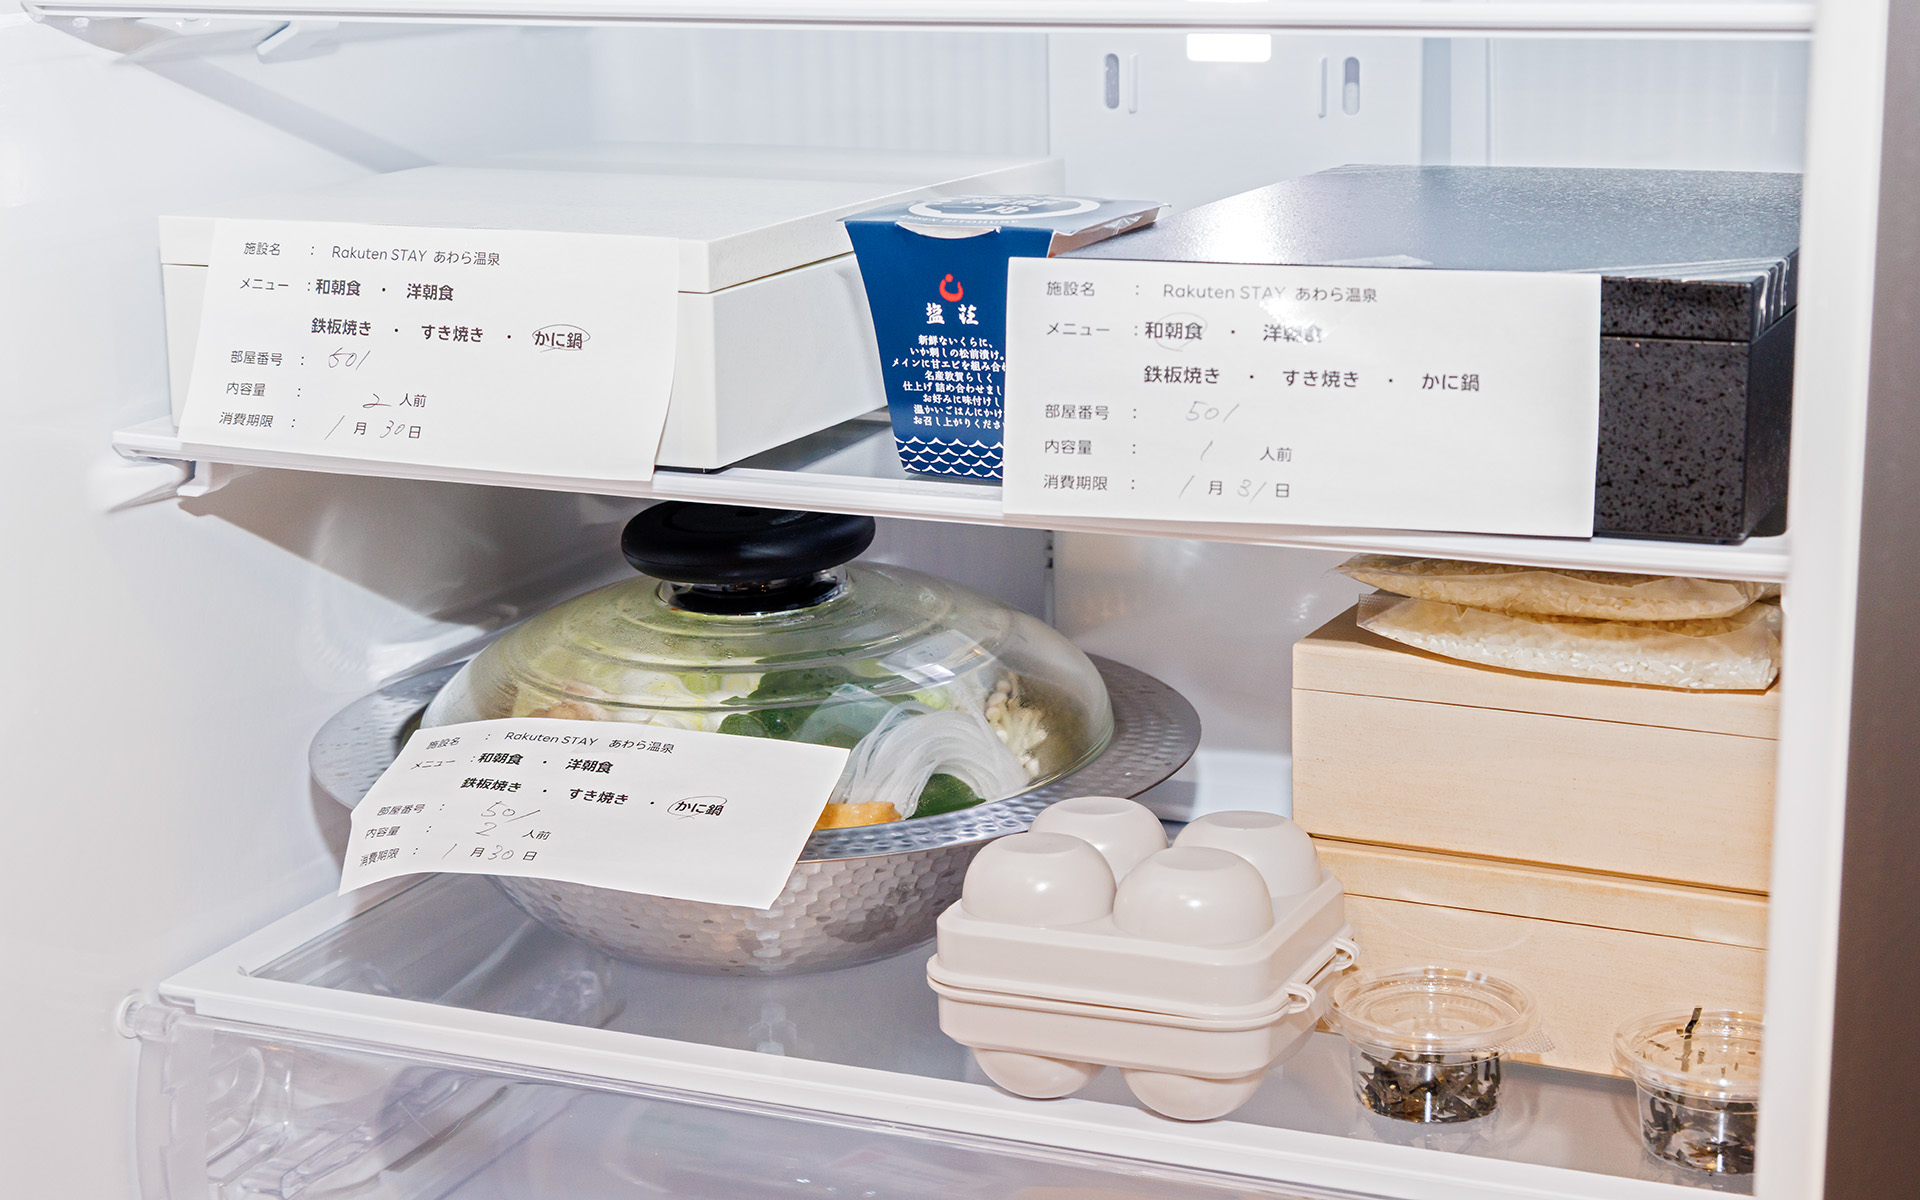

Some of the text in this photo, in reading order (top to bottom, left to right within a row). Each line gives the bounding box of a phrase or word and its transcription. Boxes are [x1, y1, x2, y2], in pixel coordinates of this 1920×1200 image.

[244, 242, 280, 255] 施設名
[332, 246, 387, 260] Rakuten
[391, 249, 427, 261] STAY
[434, 251, 499, 266] あわら温泉
[240, 278, 288, 290] メニュー
[407, 283, 454, 301] 洋朝食
[1047, 281, 1094, 296] 施設名
[1164, 284, 1234, 298] Rakuten
[1240, 286, 1286, 299] STAY
[1295, 286, 1377, 303] あわら温泉
[311, 318, 371, 336] 鉄板焼き
[422, 325, 483, 342] すき焼き
[534, 331, 583, 349] かに鍋
[1047, 323, 1109, 336] メニュー
[231, 351, 282, 366] 部屋番号
[1144, 366, 1219, 384] 鉄板焼き
[1283, 370, 1358, 387] すき焼き
[1422, 374, 1479, 391] かに鍋
[226, 382, 265, 396] 内容量
[399, 393, 426, 407] 人前
[219, 412, 273, 427] 消費期限
[1046, 404, 1109, 420] 部屋番号
[1045, 440, 1091, 455] 内容量
[1260, 447, 1292, 462] 人前
[1044, 475, 1107, 490] 消費期限
[426, 737, 460, 749] 施設名
[505, 732, 559, 743] Rakuten
[561, 736, 598, 745] STAY
[609, 740, 674, 753] あわら温泉
[411, 760, 455, 770] メニュー
[565, 759, 613, 774] 洋朝食
[460, 778, 521, 792] 鉄板焼き
[570, 789, 628, 805] すき焼き
[674, 800, 724, 816] かに鍋
[377, 804, 425, 816] 部屋番号
[365, 826, 400, 839] 内容量
[522, 830, 551, 840] 人前
[360, 848, 399, 866] 消費期限
